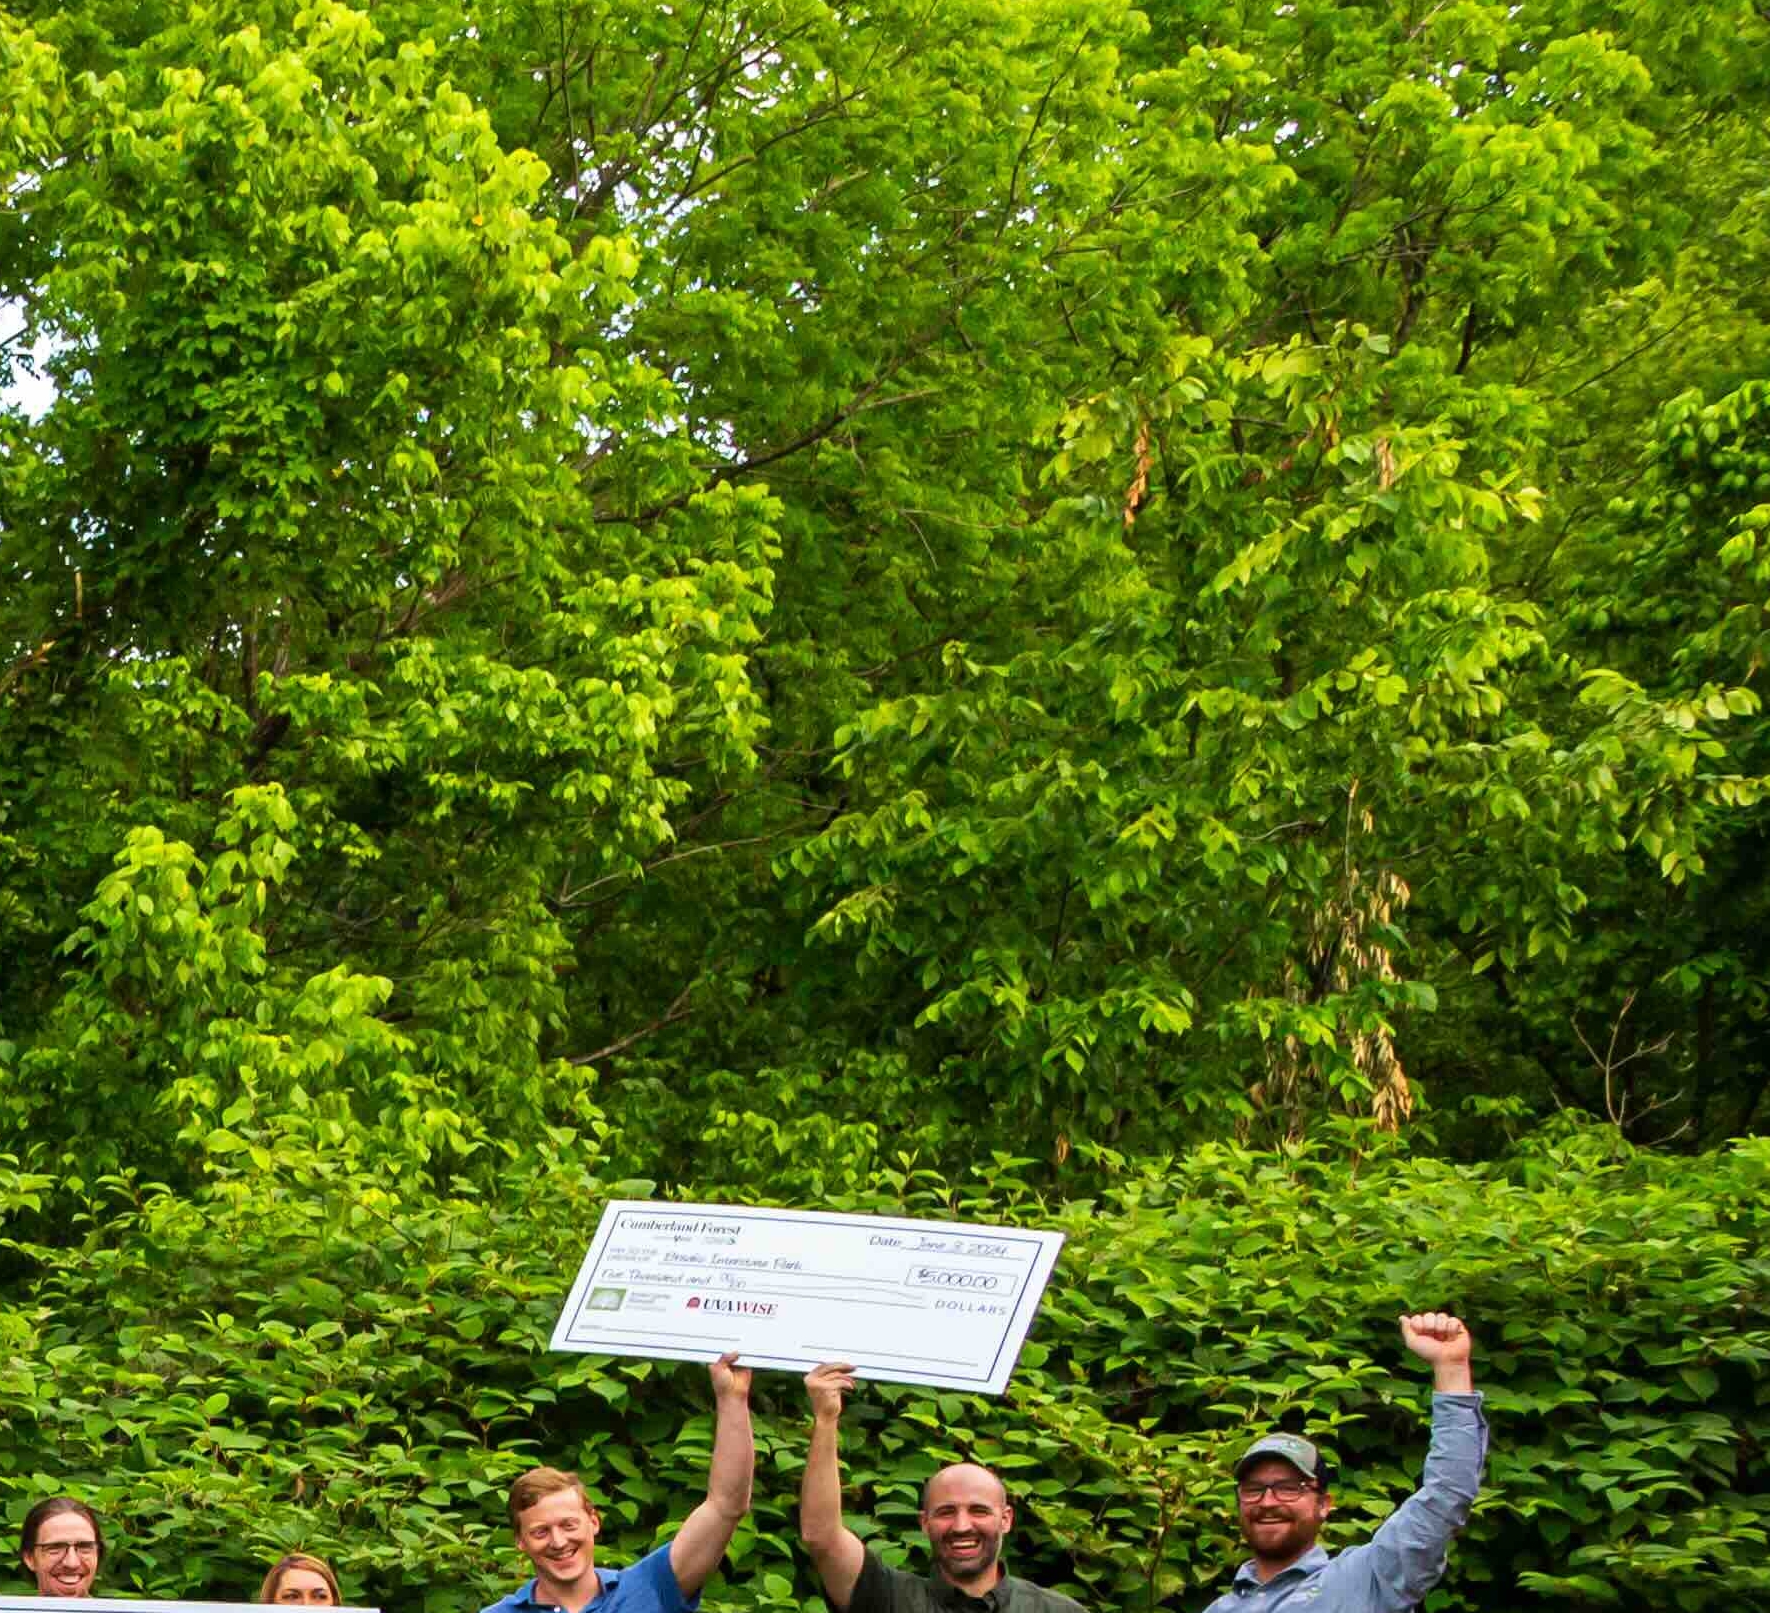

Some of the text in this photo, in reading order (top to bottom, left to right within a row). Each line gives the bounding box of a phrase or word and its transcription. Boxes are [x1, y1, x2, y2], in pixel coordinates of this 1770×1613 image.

[620, 1219, 741, 1235] Cumberland Forest
[869, 1236, 903, 1246] Date
[934, 1300, 1007, 1314] DOLLARS
